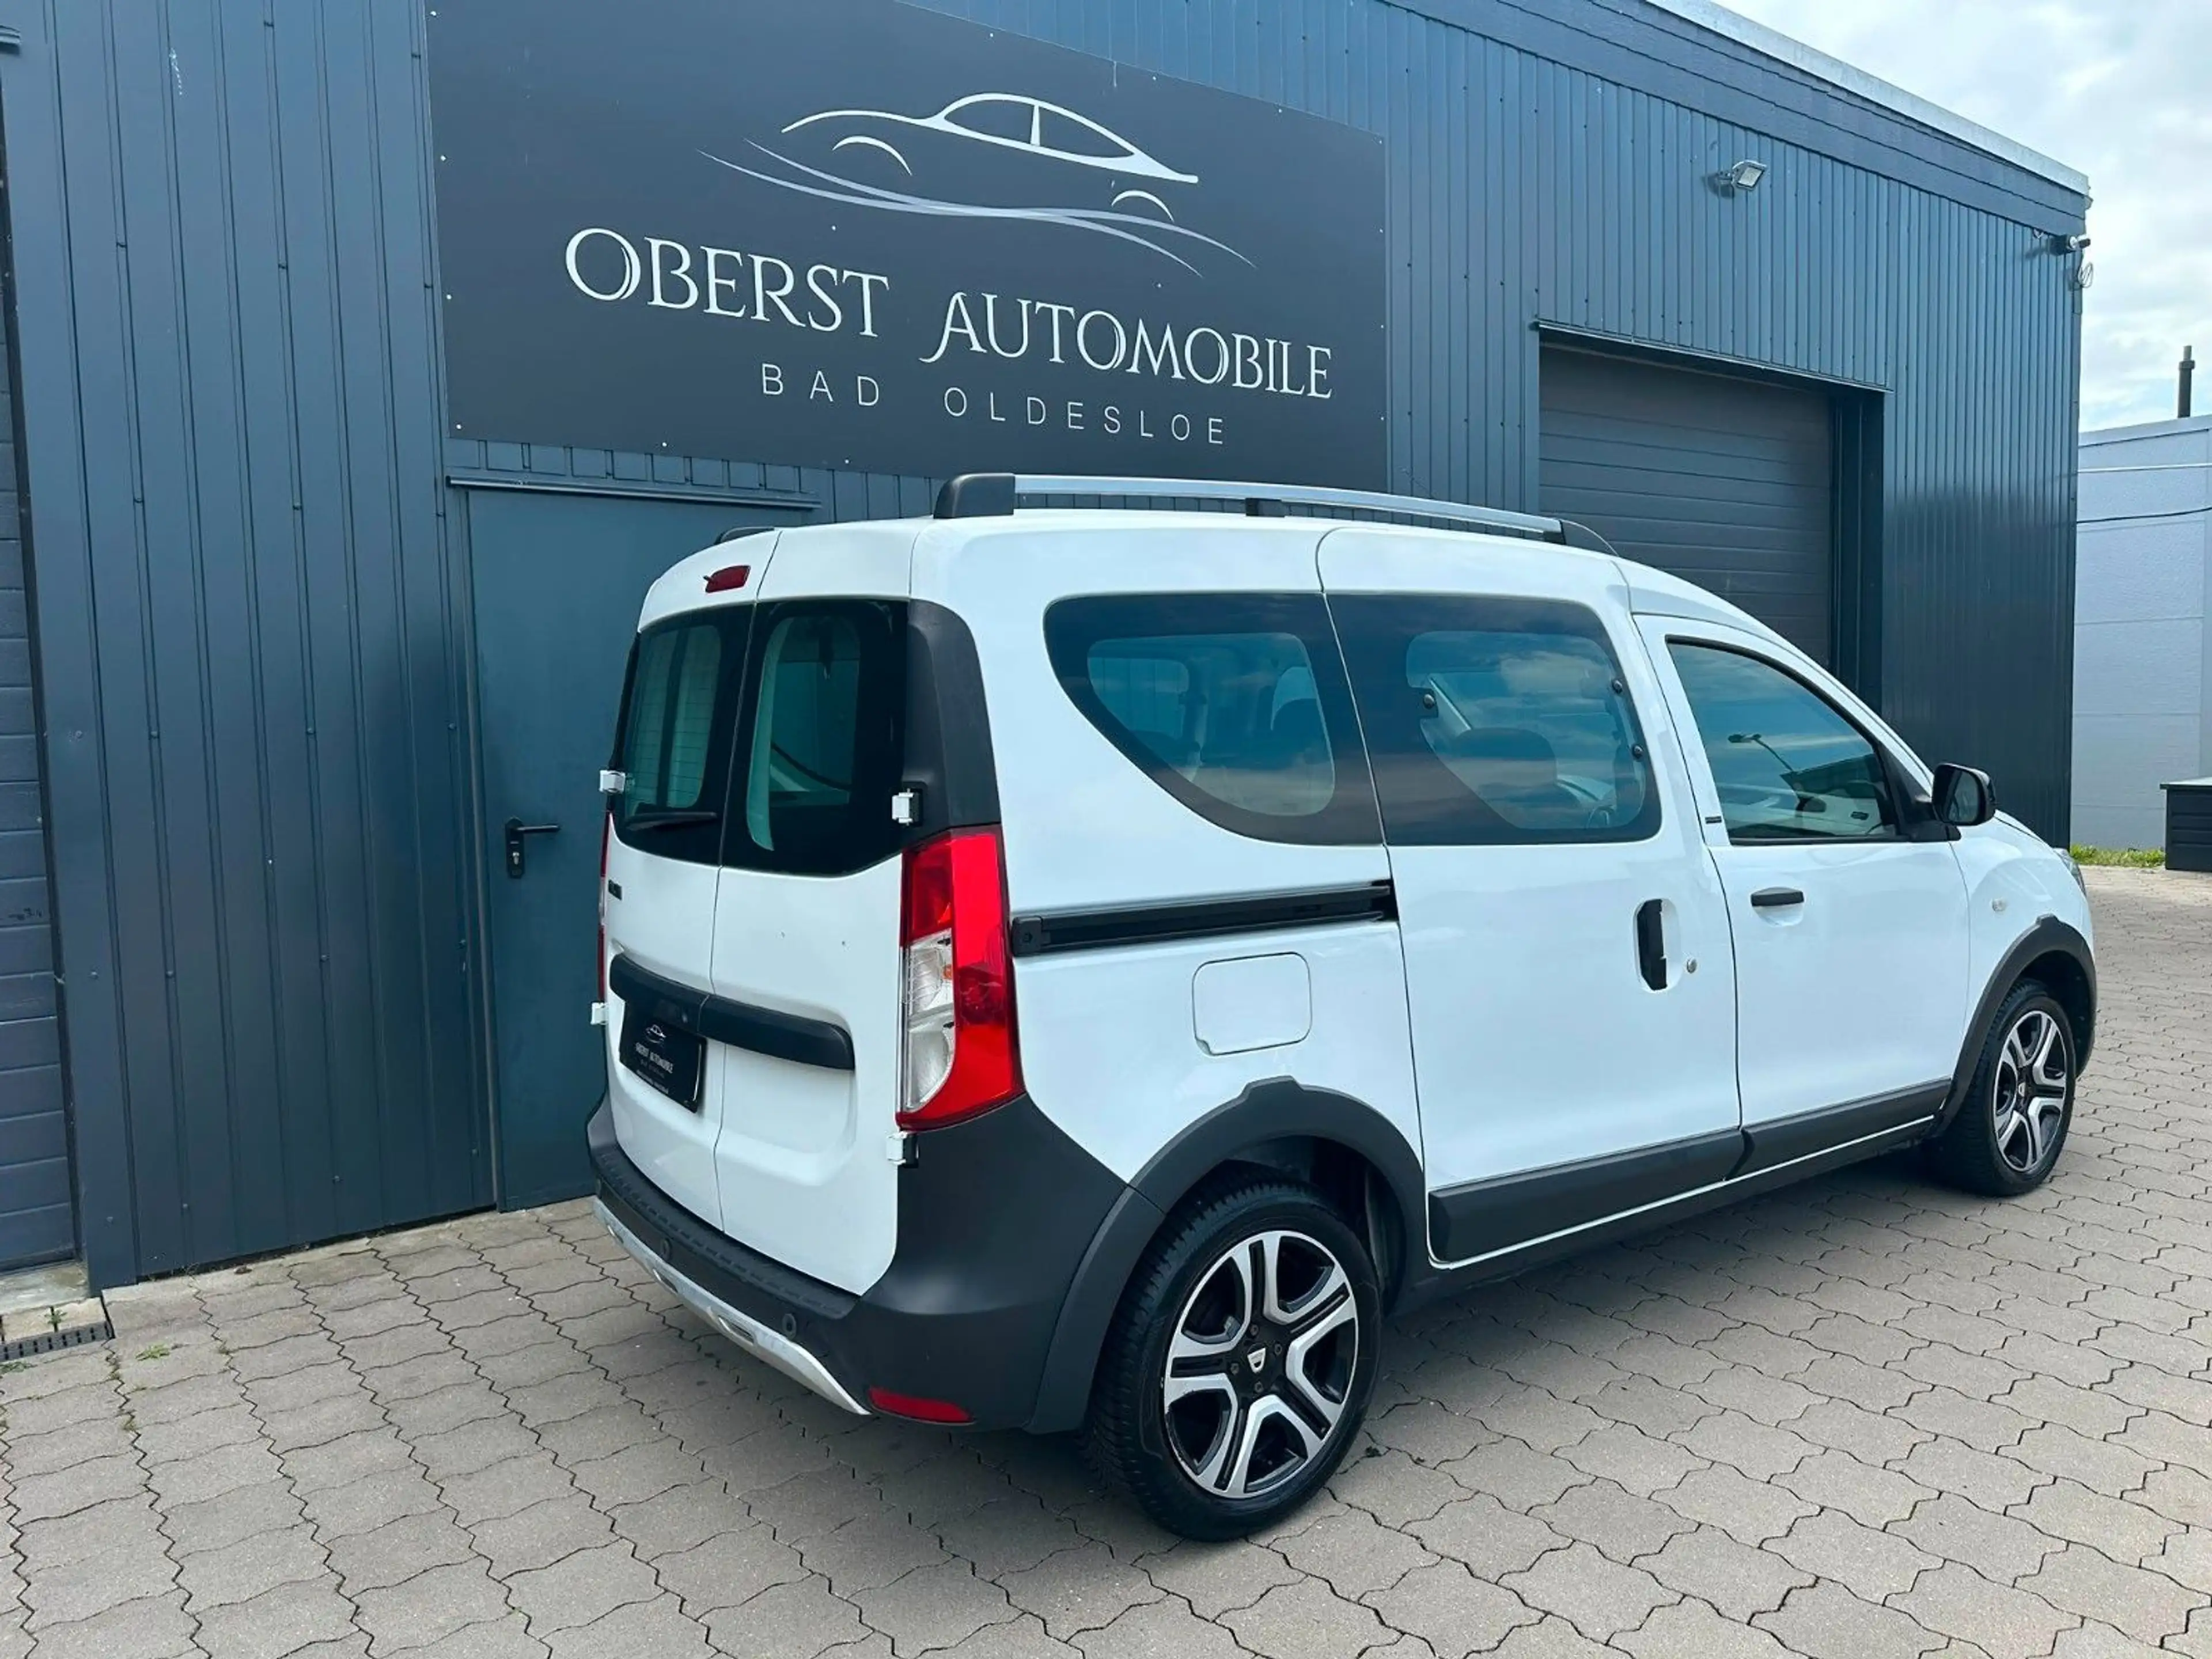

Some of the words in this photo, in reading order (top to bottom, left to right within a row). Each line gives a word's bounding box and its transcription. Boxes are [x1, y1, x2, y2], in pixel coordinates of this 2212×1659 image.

[565, 228, 889, 337] OBERST
[920, 292, 1331, 399] AUTOMOBILE
[761, 363, 880, 407] BAD
[944, 387, 1223, 445] OLDESLOE
